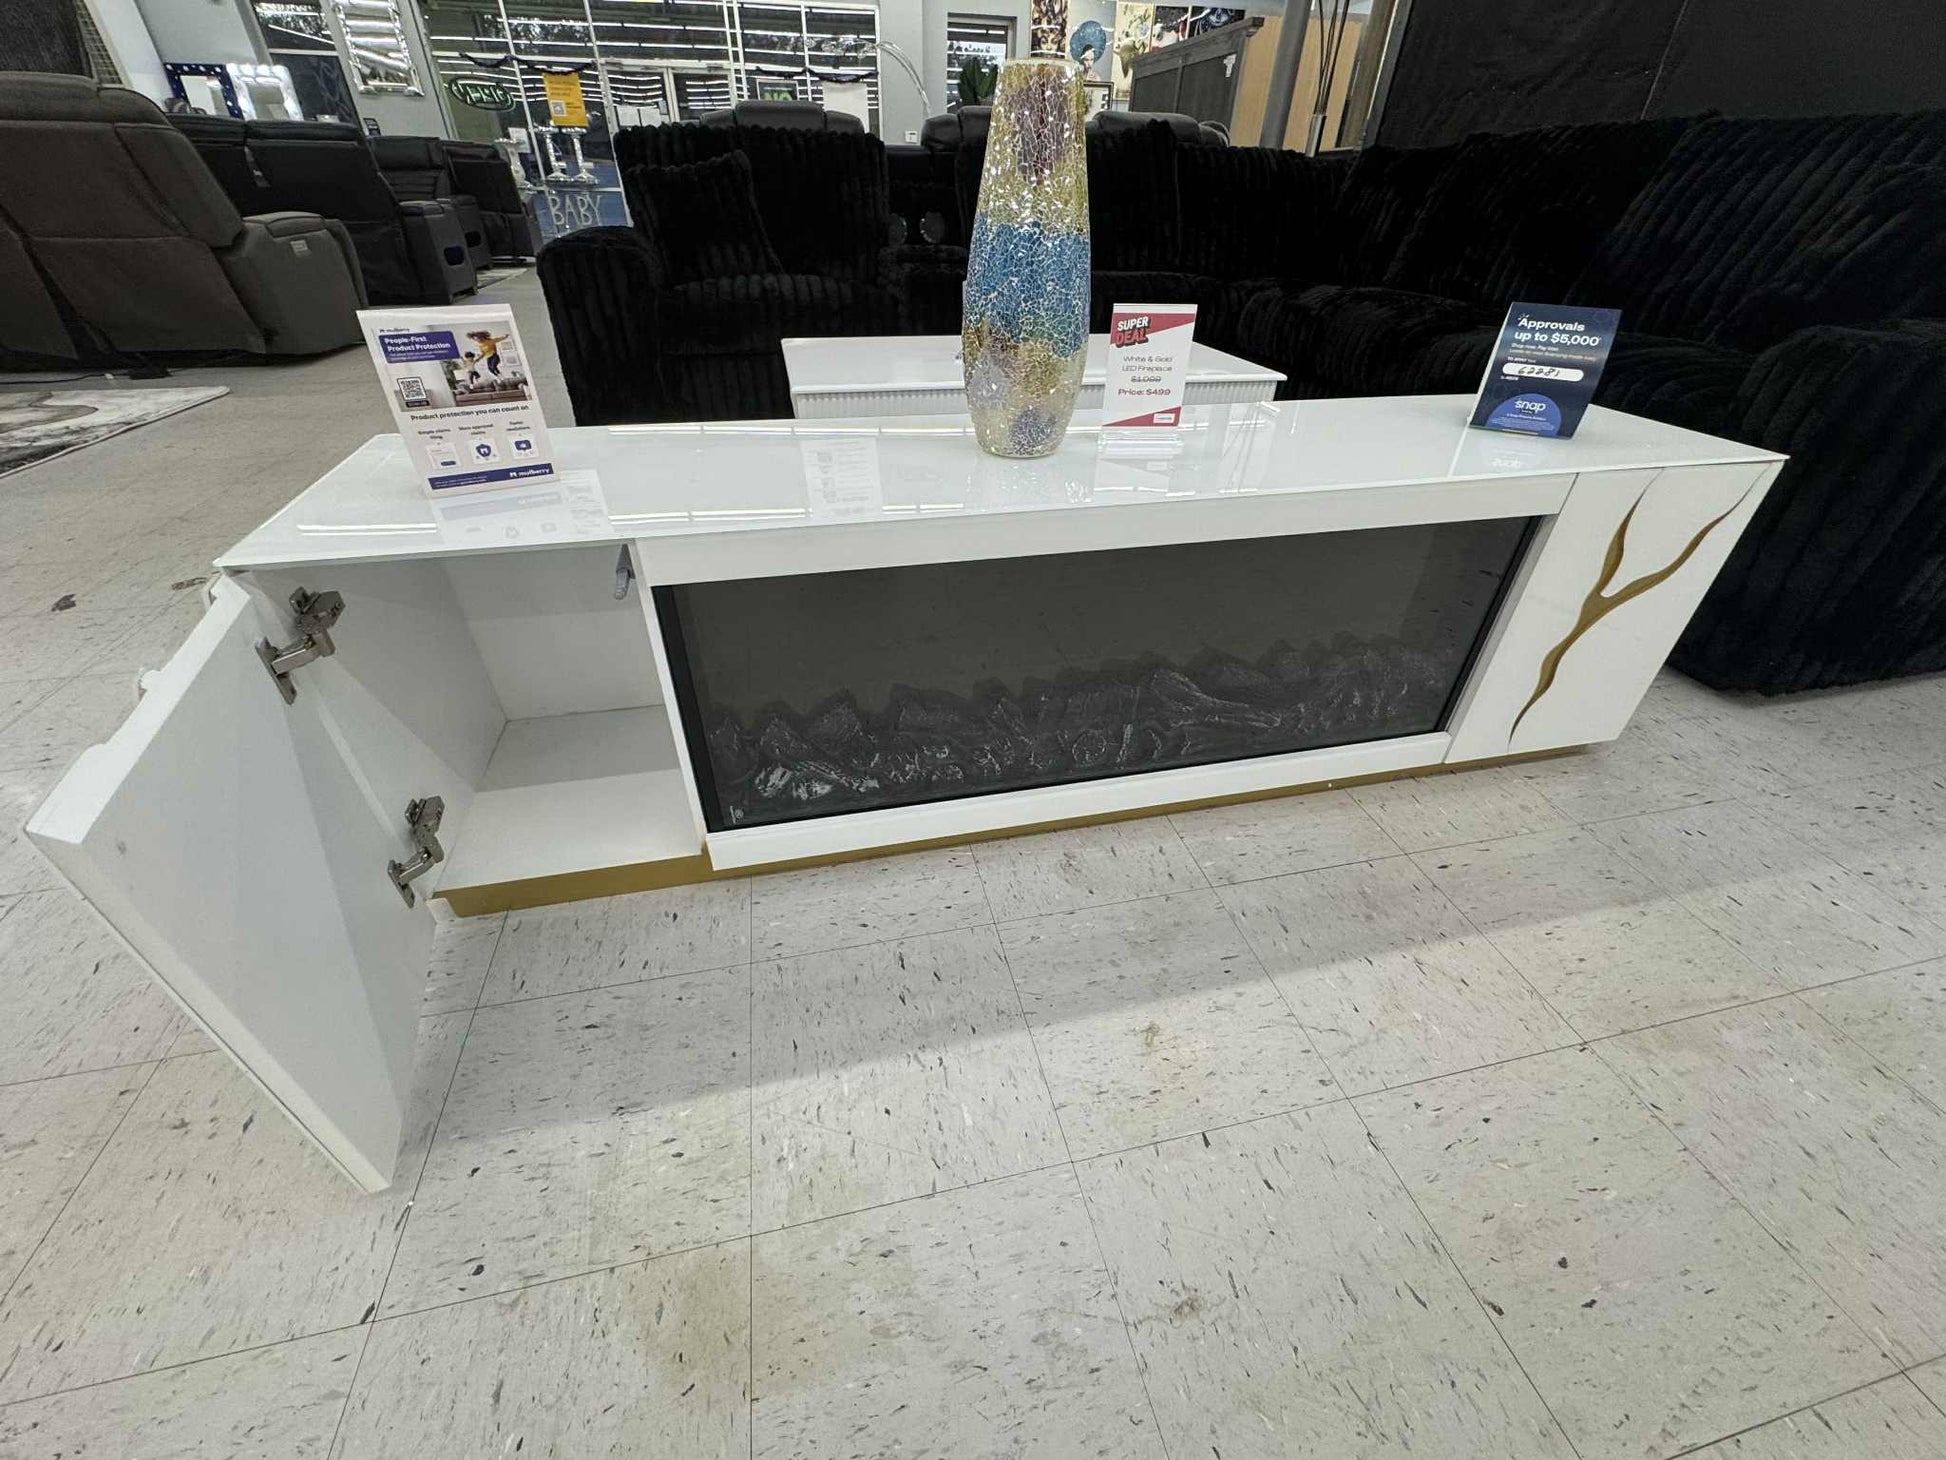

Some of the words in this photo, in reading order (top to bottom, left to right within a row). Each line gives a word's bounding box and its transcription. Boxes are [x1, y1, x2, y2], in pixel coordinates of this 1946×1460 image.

[550, 195, 602, 225] BABY
[1117, 316, 1149, 331] SUPER
[1518, 318, 1585, 332] Approvals
[384, 336, 427, 345] People-First
[1116, 329, 1148, 346] DEAL
[1514, 331, 1532, 342] up
[1534, 332, 1548, 341] to
[1551, 332, 1600, 346] $5,000
[387, 345, 416, 353] Product
[1118, 388, 1145, 396] Price:
[1146, 388, 1171, 396] $499
[1514, 400, 1546, 414] snap
[411, 413, 439, 421] Product
[440, 410, 475, 419] protection
[519, 469, 550, 478] mulberry
